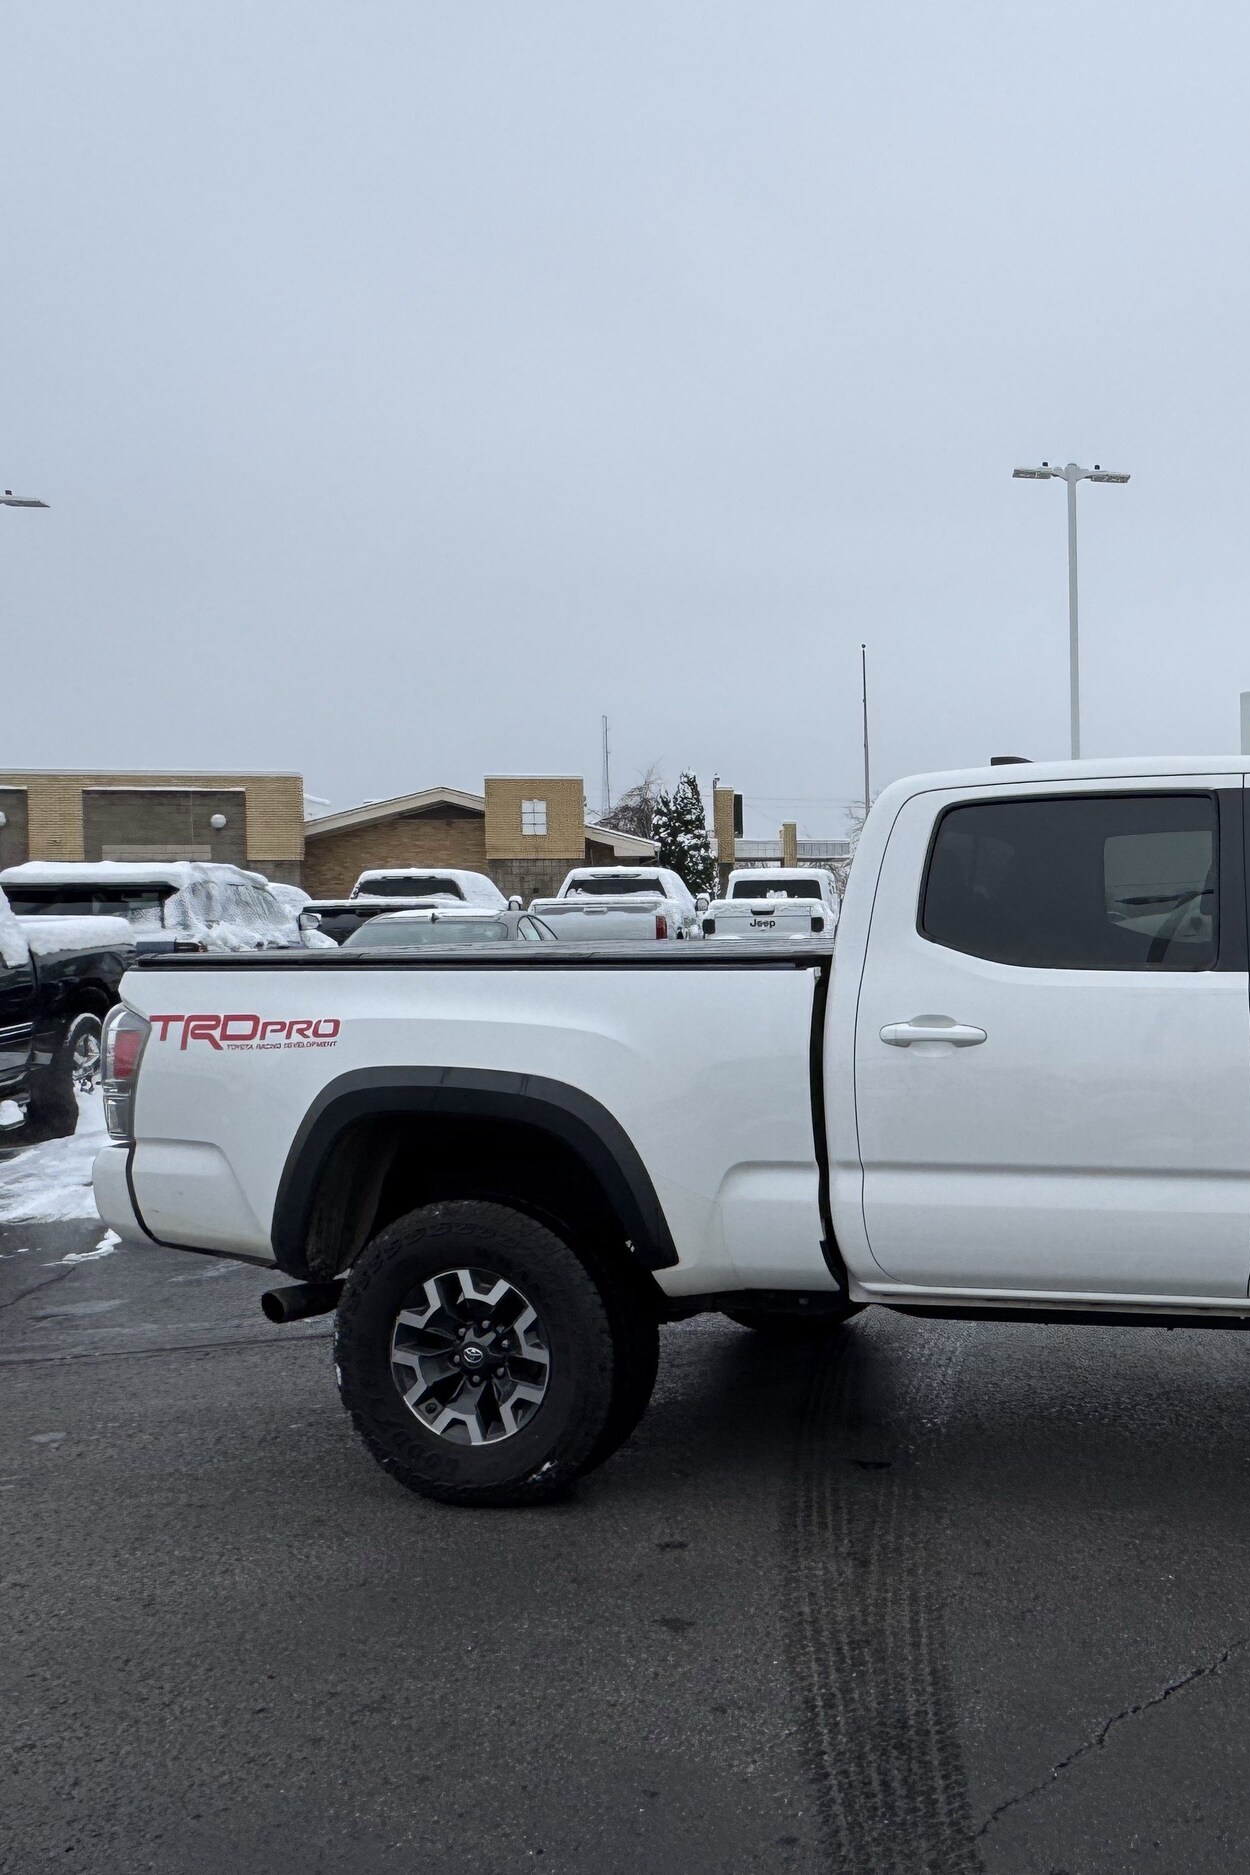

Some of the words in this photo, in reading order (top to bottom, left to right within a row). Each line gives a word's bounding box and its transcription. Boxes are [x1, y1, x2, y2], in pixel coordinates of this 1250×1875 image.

[749, 918, 776, 929] Jeep
[149, 1014, 260, 1051] TRD
[259, 1018, 341, 1041] PRO
